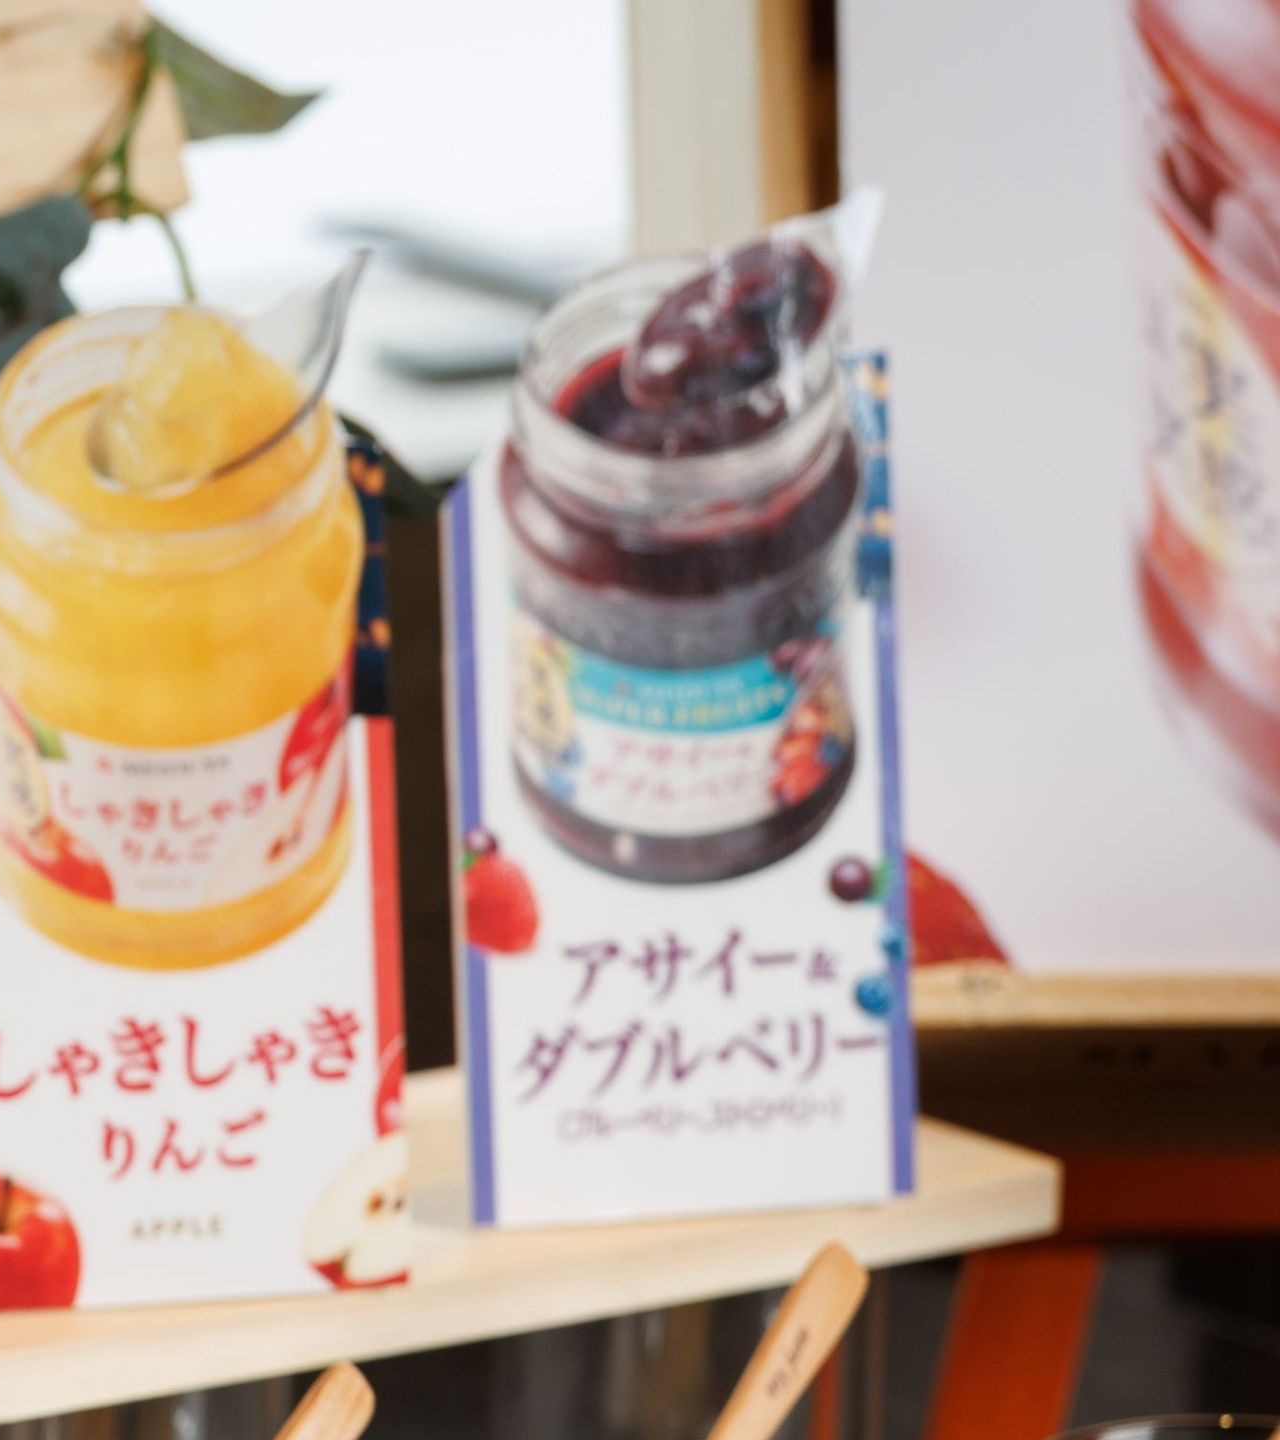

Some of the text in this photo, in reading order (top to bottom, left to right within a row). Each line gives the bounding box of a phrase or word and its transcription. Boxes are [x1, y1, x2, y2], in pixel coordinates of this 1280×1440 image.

[517, 1011, 881, 1106] ダブルベリー
[100, 1108, 268, 1181] りんご
